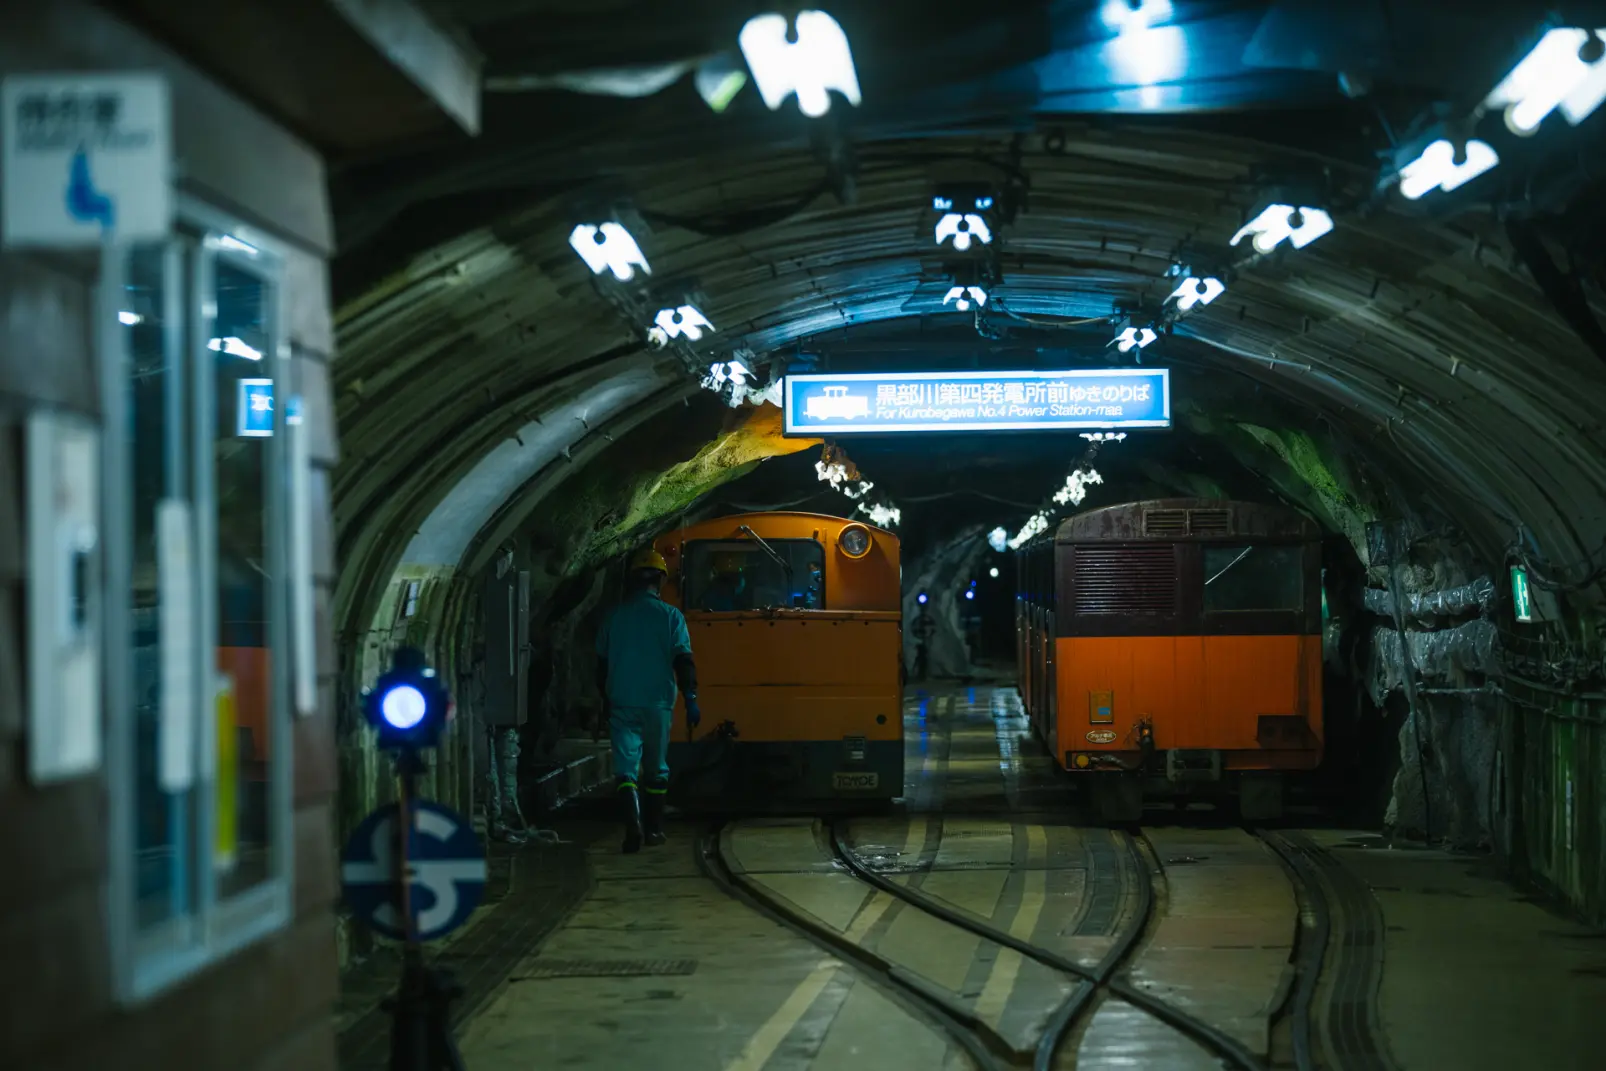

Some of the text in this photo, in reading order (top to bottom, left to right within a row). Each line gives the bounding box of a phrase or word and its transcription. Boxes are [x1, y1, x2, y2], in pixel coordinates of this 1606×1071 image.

[876, 407, 897, 419] For
[977, 405, 1006, 418] No.4
[1008, 404, 1048, 417] Power
